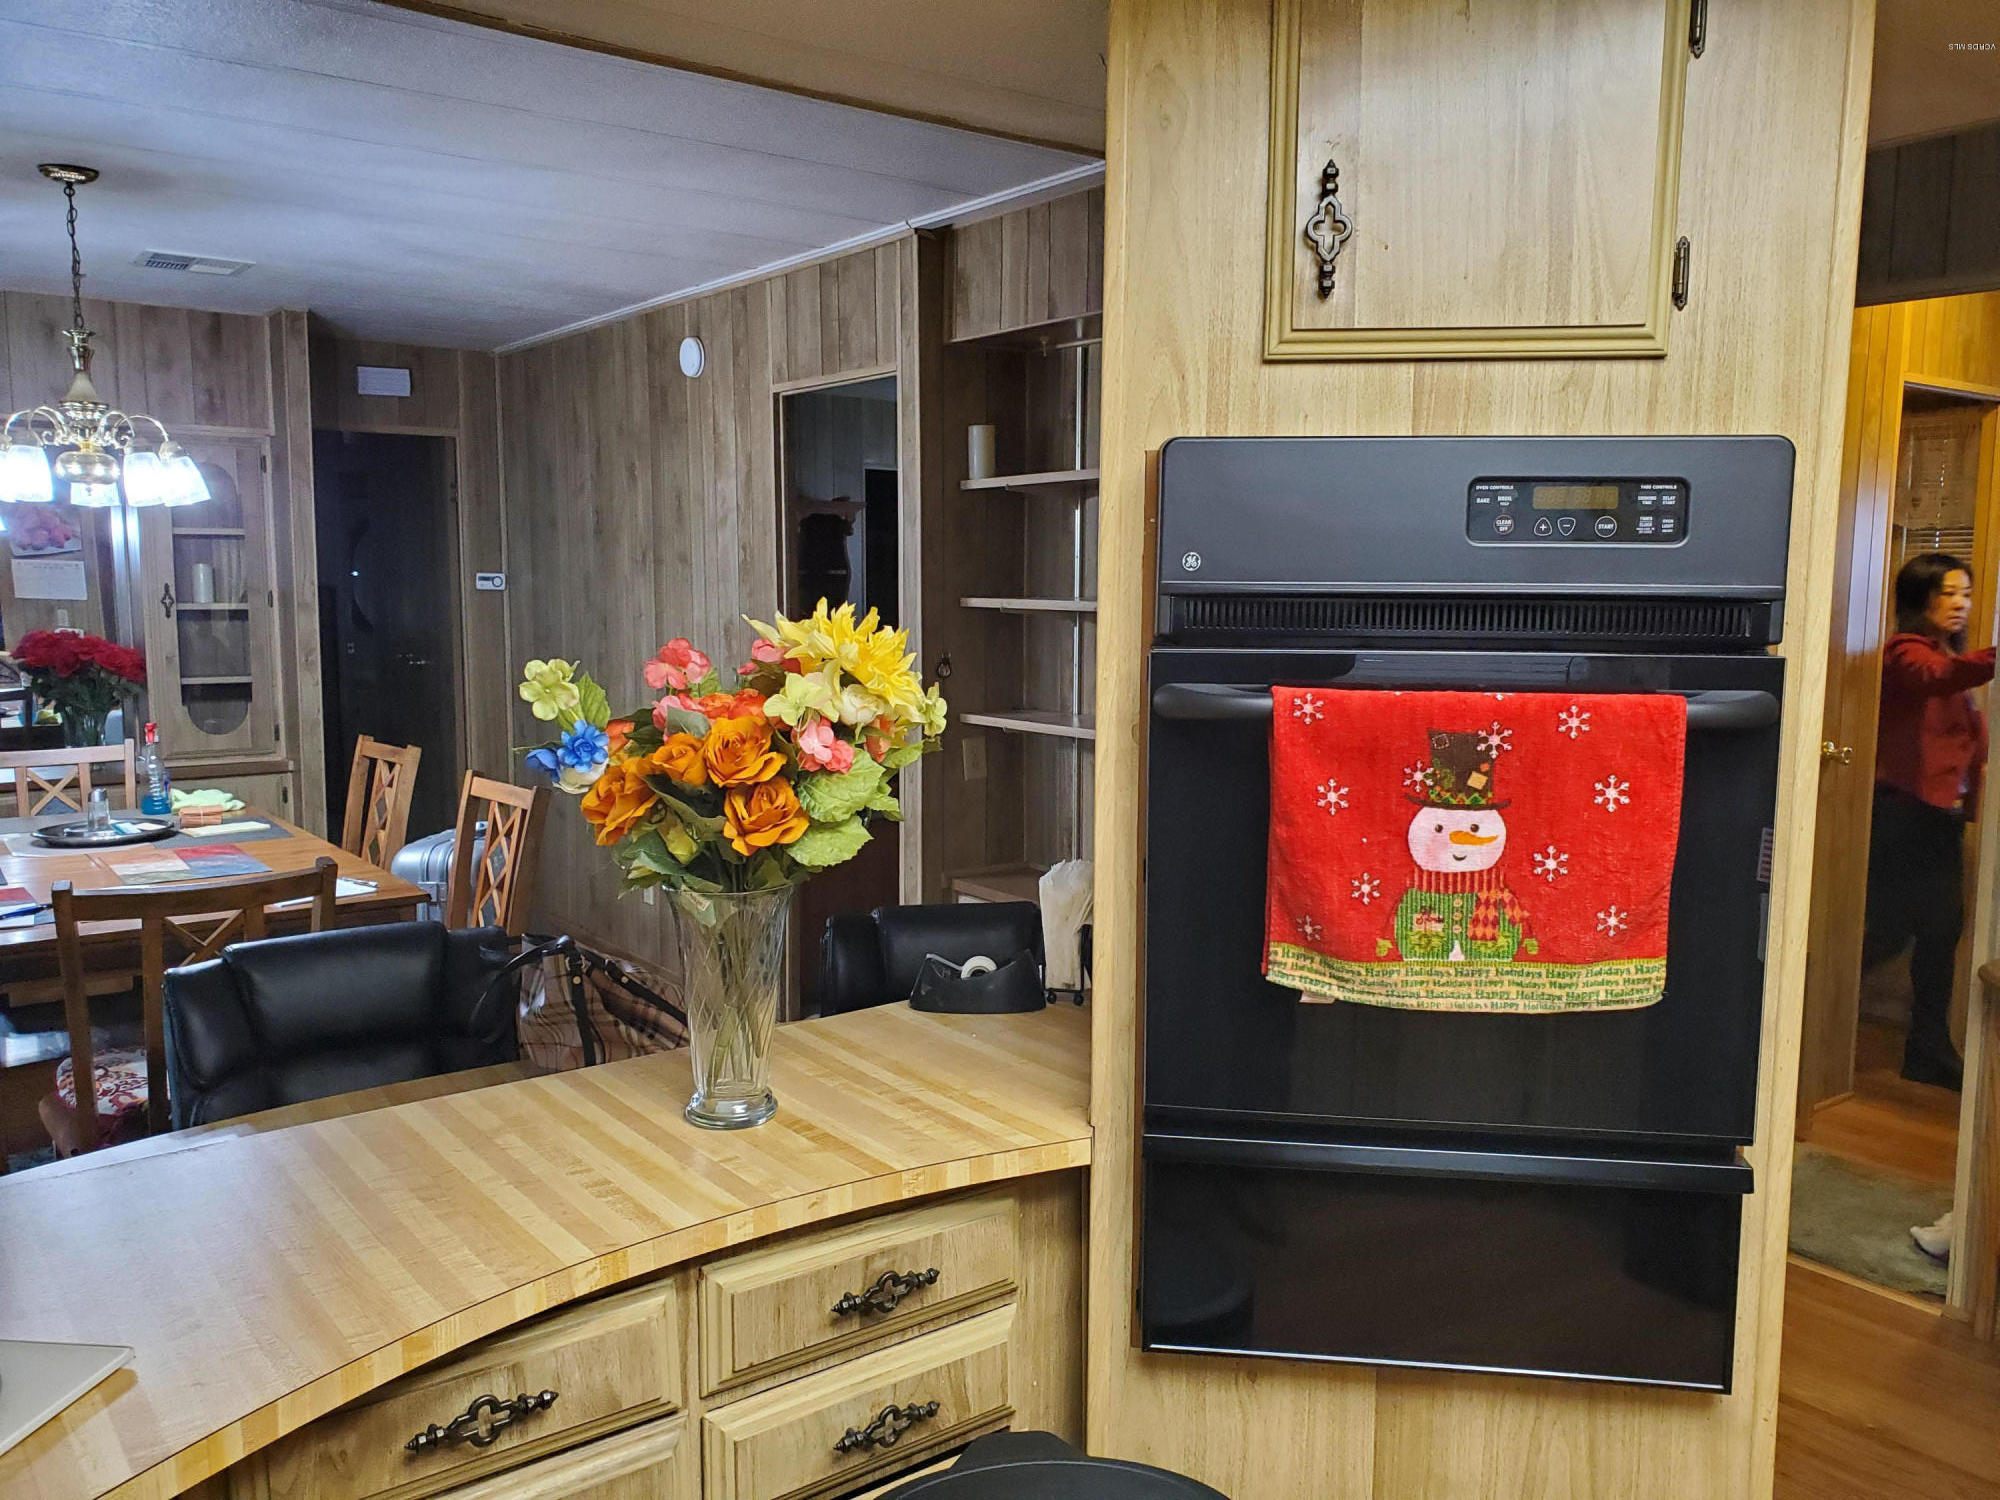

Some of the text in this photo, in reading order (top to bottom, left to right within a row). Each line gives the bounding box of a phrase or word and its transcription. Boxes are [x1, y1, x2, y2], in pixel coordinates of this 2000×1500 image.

[1365, 967, 1401, 978] Happy
[1405, 967, 1451, 978] Holidays
[1454, 967, 1491, 979] Happy
[1546, 969, 1582, 979] Happy
[1585, 967, 1631, 978] Holidays
